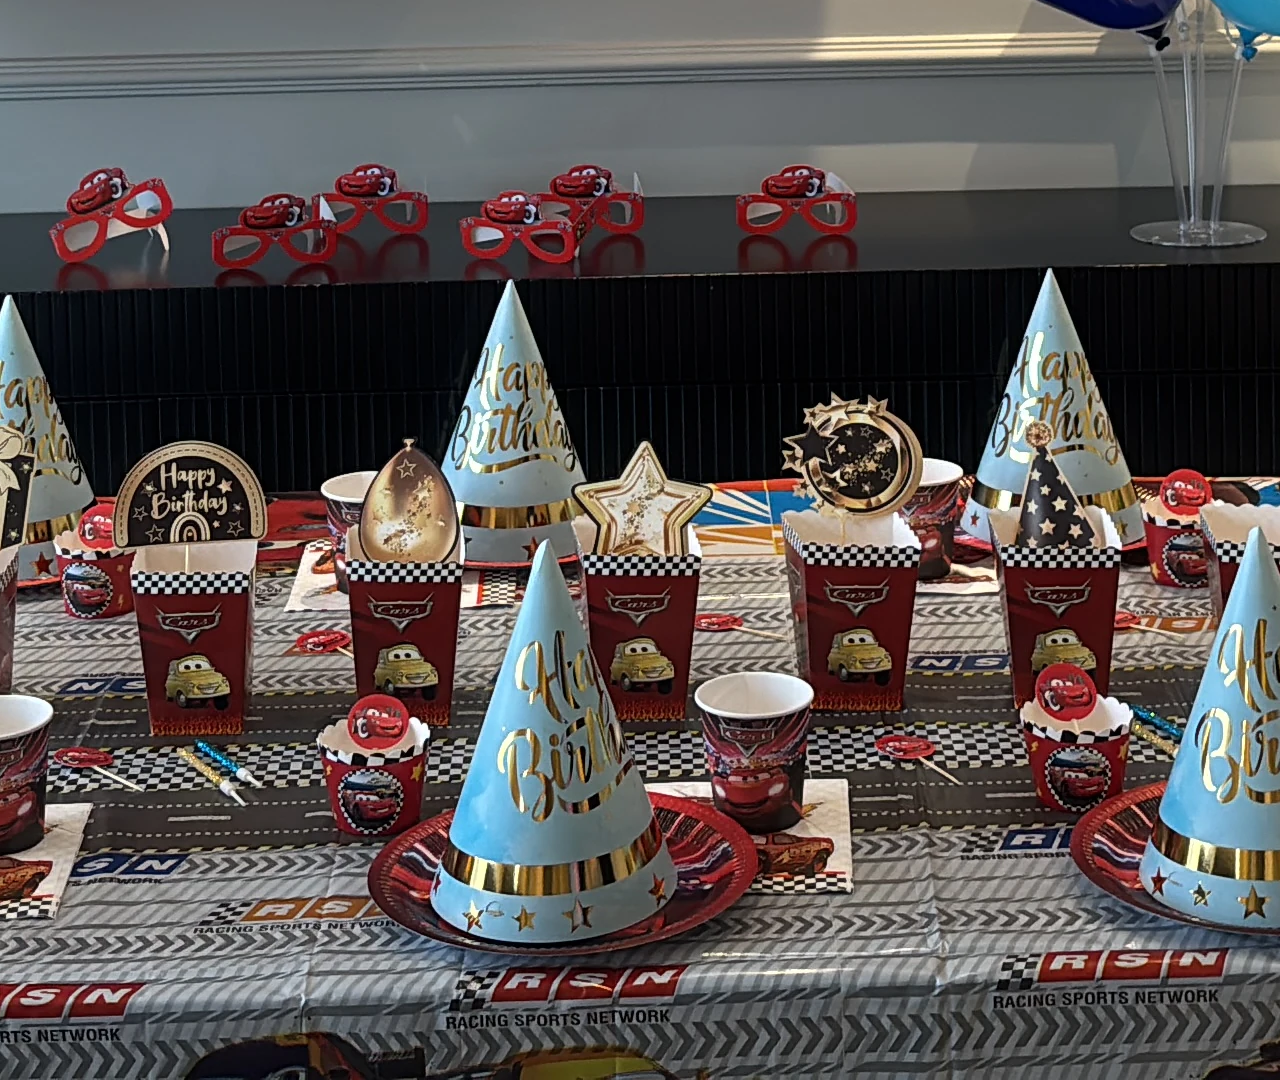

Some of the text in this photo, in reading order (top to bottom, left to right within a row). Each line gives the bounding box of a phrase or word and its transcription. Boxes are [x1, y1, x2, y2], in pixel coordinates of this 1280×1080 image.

[160, 462, 216, 491] Happy
[150, 490, 228, 520] Birthday
[327, 920, 403, 930] NETWOR
[1049, 951, 1220, 970] RSN
[503, 970, 679, 990] RSN
[993, 989, 1219, 1009] RACING SPORTS NETWORK
[446, 1009, 671, 1029] RACING SPORTS NETWORK
[37, 1027, 121, 1042] NETWORK
